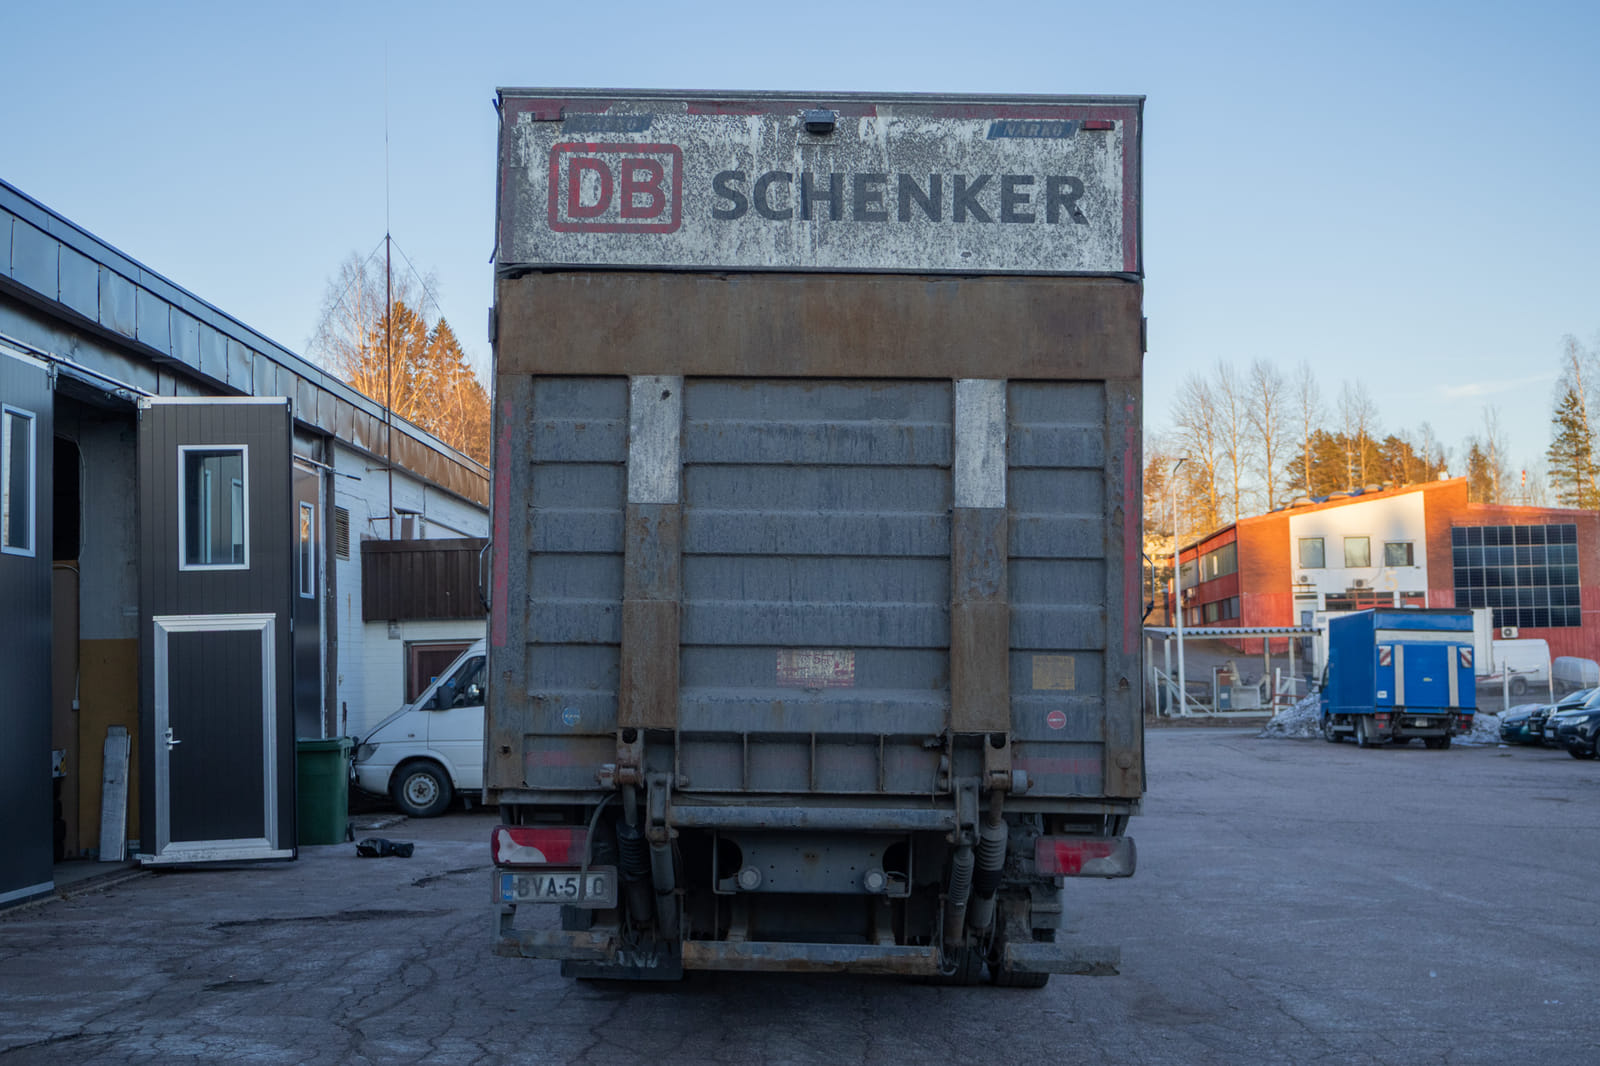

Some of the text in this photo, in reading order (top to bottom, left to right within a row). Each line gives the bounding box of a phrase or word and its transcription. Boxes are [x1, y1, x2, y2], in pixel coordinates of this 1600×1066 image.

[568, 157, 1090, 225] DB SCHENKER
[1384, 570, 1399, 591] 5
[517, 876, 604, 898] BVA-50
